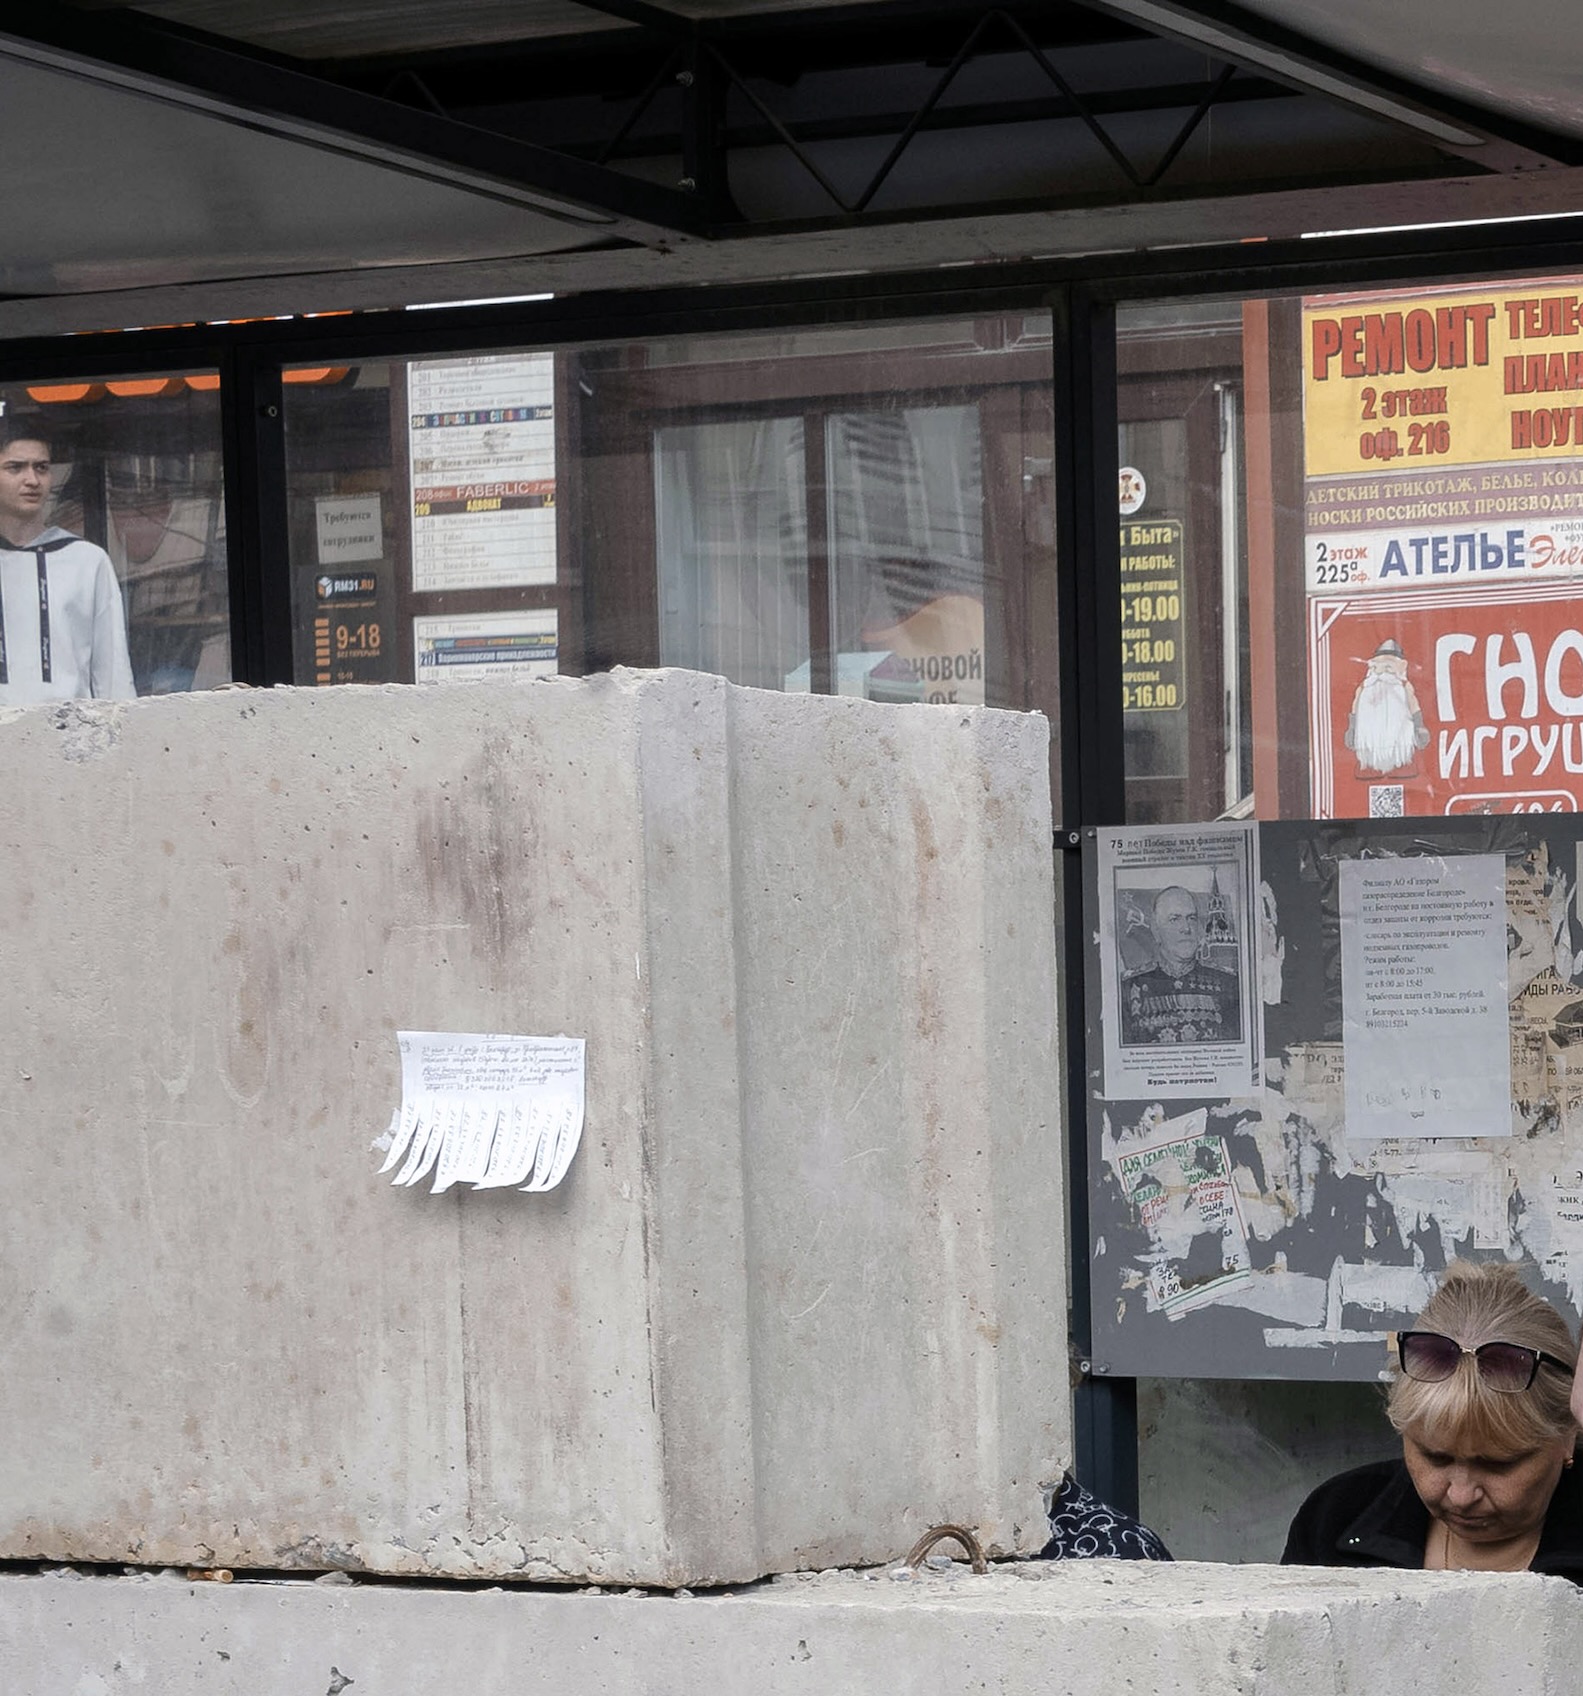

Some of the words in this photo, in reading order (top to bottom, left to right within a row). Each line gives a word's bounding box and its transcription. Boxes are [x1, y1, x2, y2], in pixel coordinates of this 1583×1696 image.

[1312, 303, 1495, 381] РЕМОНТ
[1361, 387, 1377, 420] 2
[1381, 386, 1448, 418] этаж
[1360, 428, 1404, 461] оф.
[1407, 420, 1451, 455] 216
[457, 481, 529, 498] FABERLIC
[1306, 482, 1379, 504] ДЕТСКИЙ
[1383, 477, 1478, 498] ТРИКОТАЖ,
[1481, 471, 1537, 491] БЕЛЬЕ,
[323, 512, 371, 524] Требуются
[1307, 507, 1362, 527] НОСКИ
[1366, 499, 1470, 522] РОССИЙСКИХ
[323, 535, 375, 548] сотрудники
[1316, 542, 1327, 563] 2
[1330, 546, 1368, 561] этаж
[1379, 529, 1525, 579] АТЕЛЬЕ
[1350, 570, 1371, 584] оф.
[336, 624, 381, 650] 9-18
[1111, 839, 1122, 849] 75
